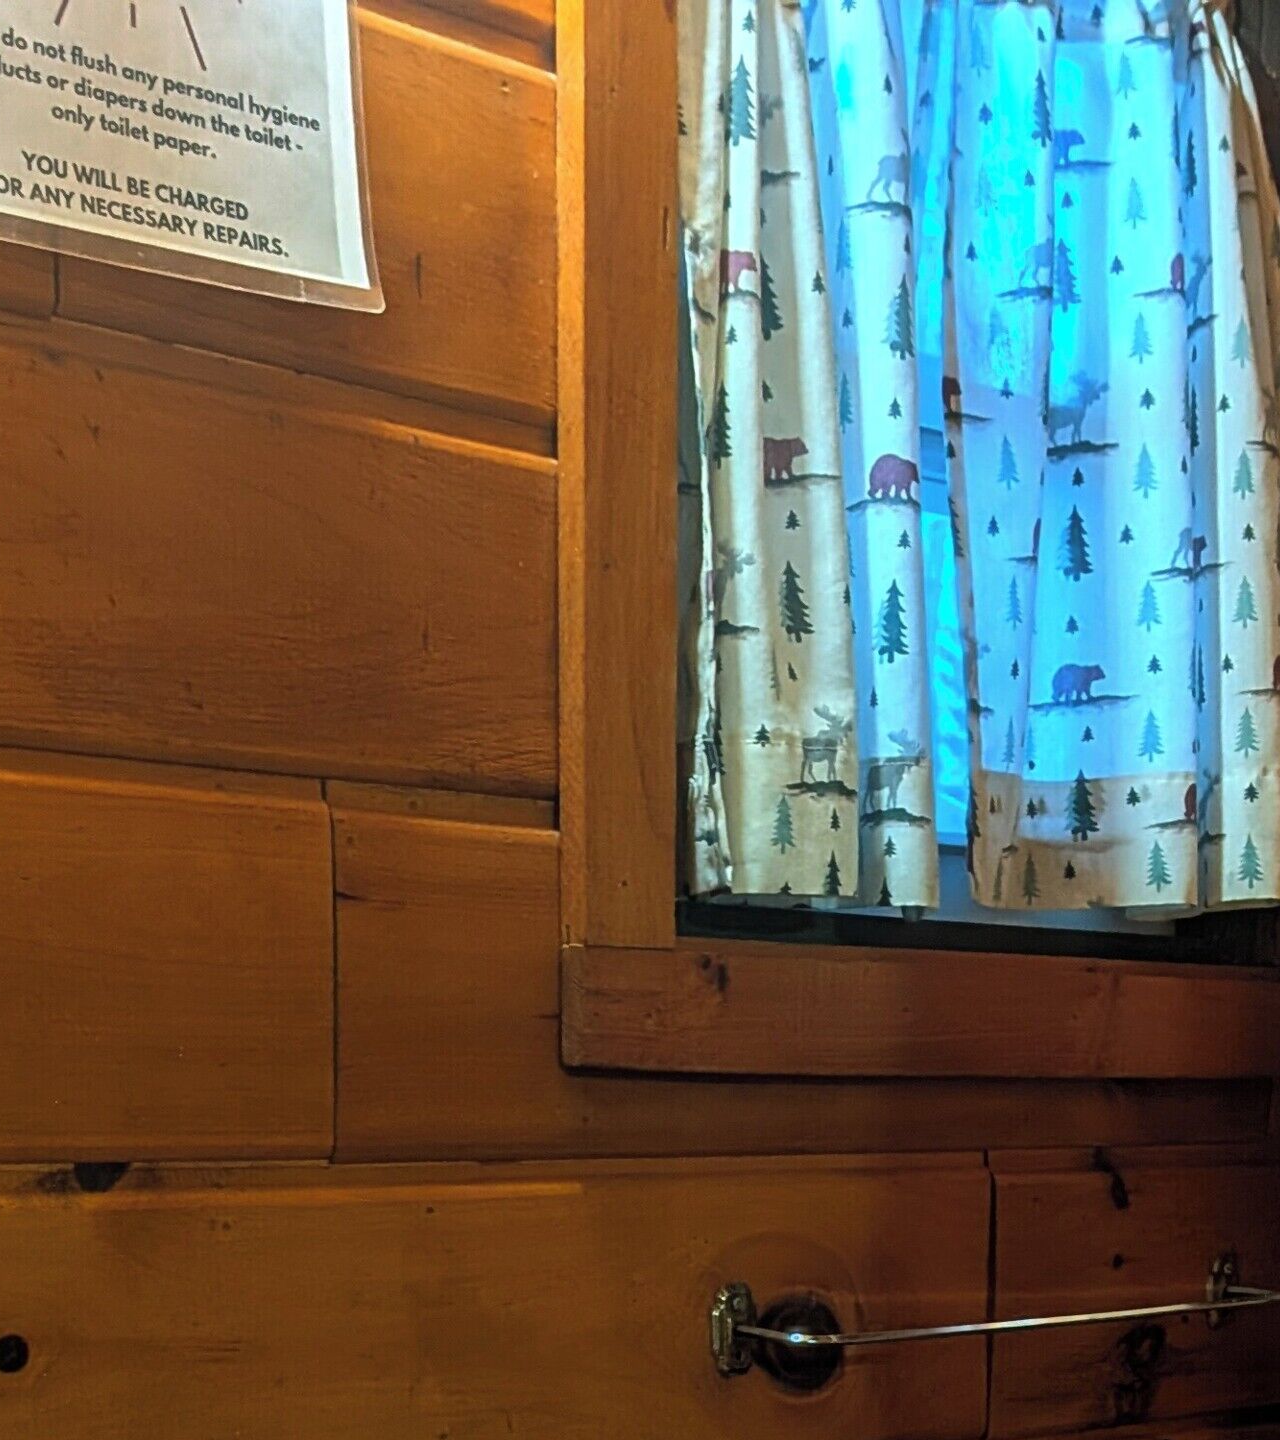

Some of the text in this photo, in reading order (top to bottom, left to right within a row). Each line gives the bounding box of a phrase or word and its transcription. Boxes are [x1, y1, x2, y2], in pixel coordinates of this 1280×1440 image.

[1, 27, 28, 50] do
[33, 41, 67, 62] not
[71, 45, 117, 76] flush
[122, 66, 158, 91] any
[163, 77, 244, 111] personal
[248, 94, 320, 131] hygiene
[46, 74, 69, 90] or
[74, 77, 147, 113] diapers
[152, 98, 206, 129] down
[210, 113, 240, 137] the
[244, 123, 292, 151] toilet
[51, 104, 217, 159] only toilet paper.
[21, 151, 249, 221] YOU WILL BE CHARGED
[30, 183, 75, 209] ANY
[80, 195, 199, 237] NECESSARY
[204, 222, 289, 257] REPAIRS.
